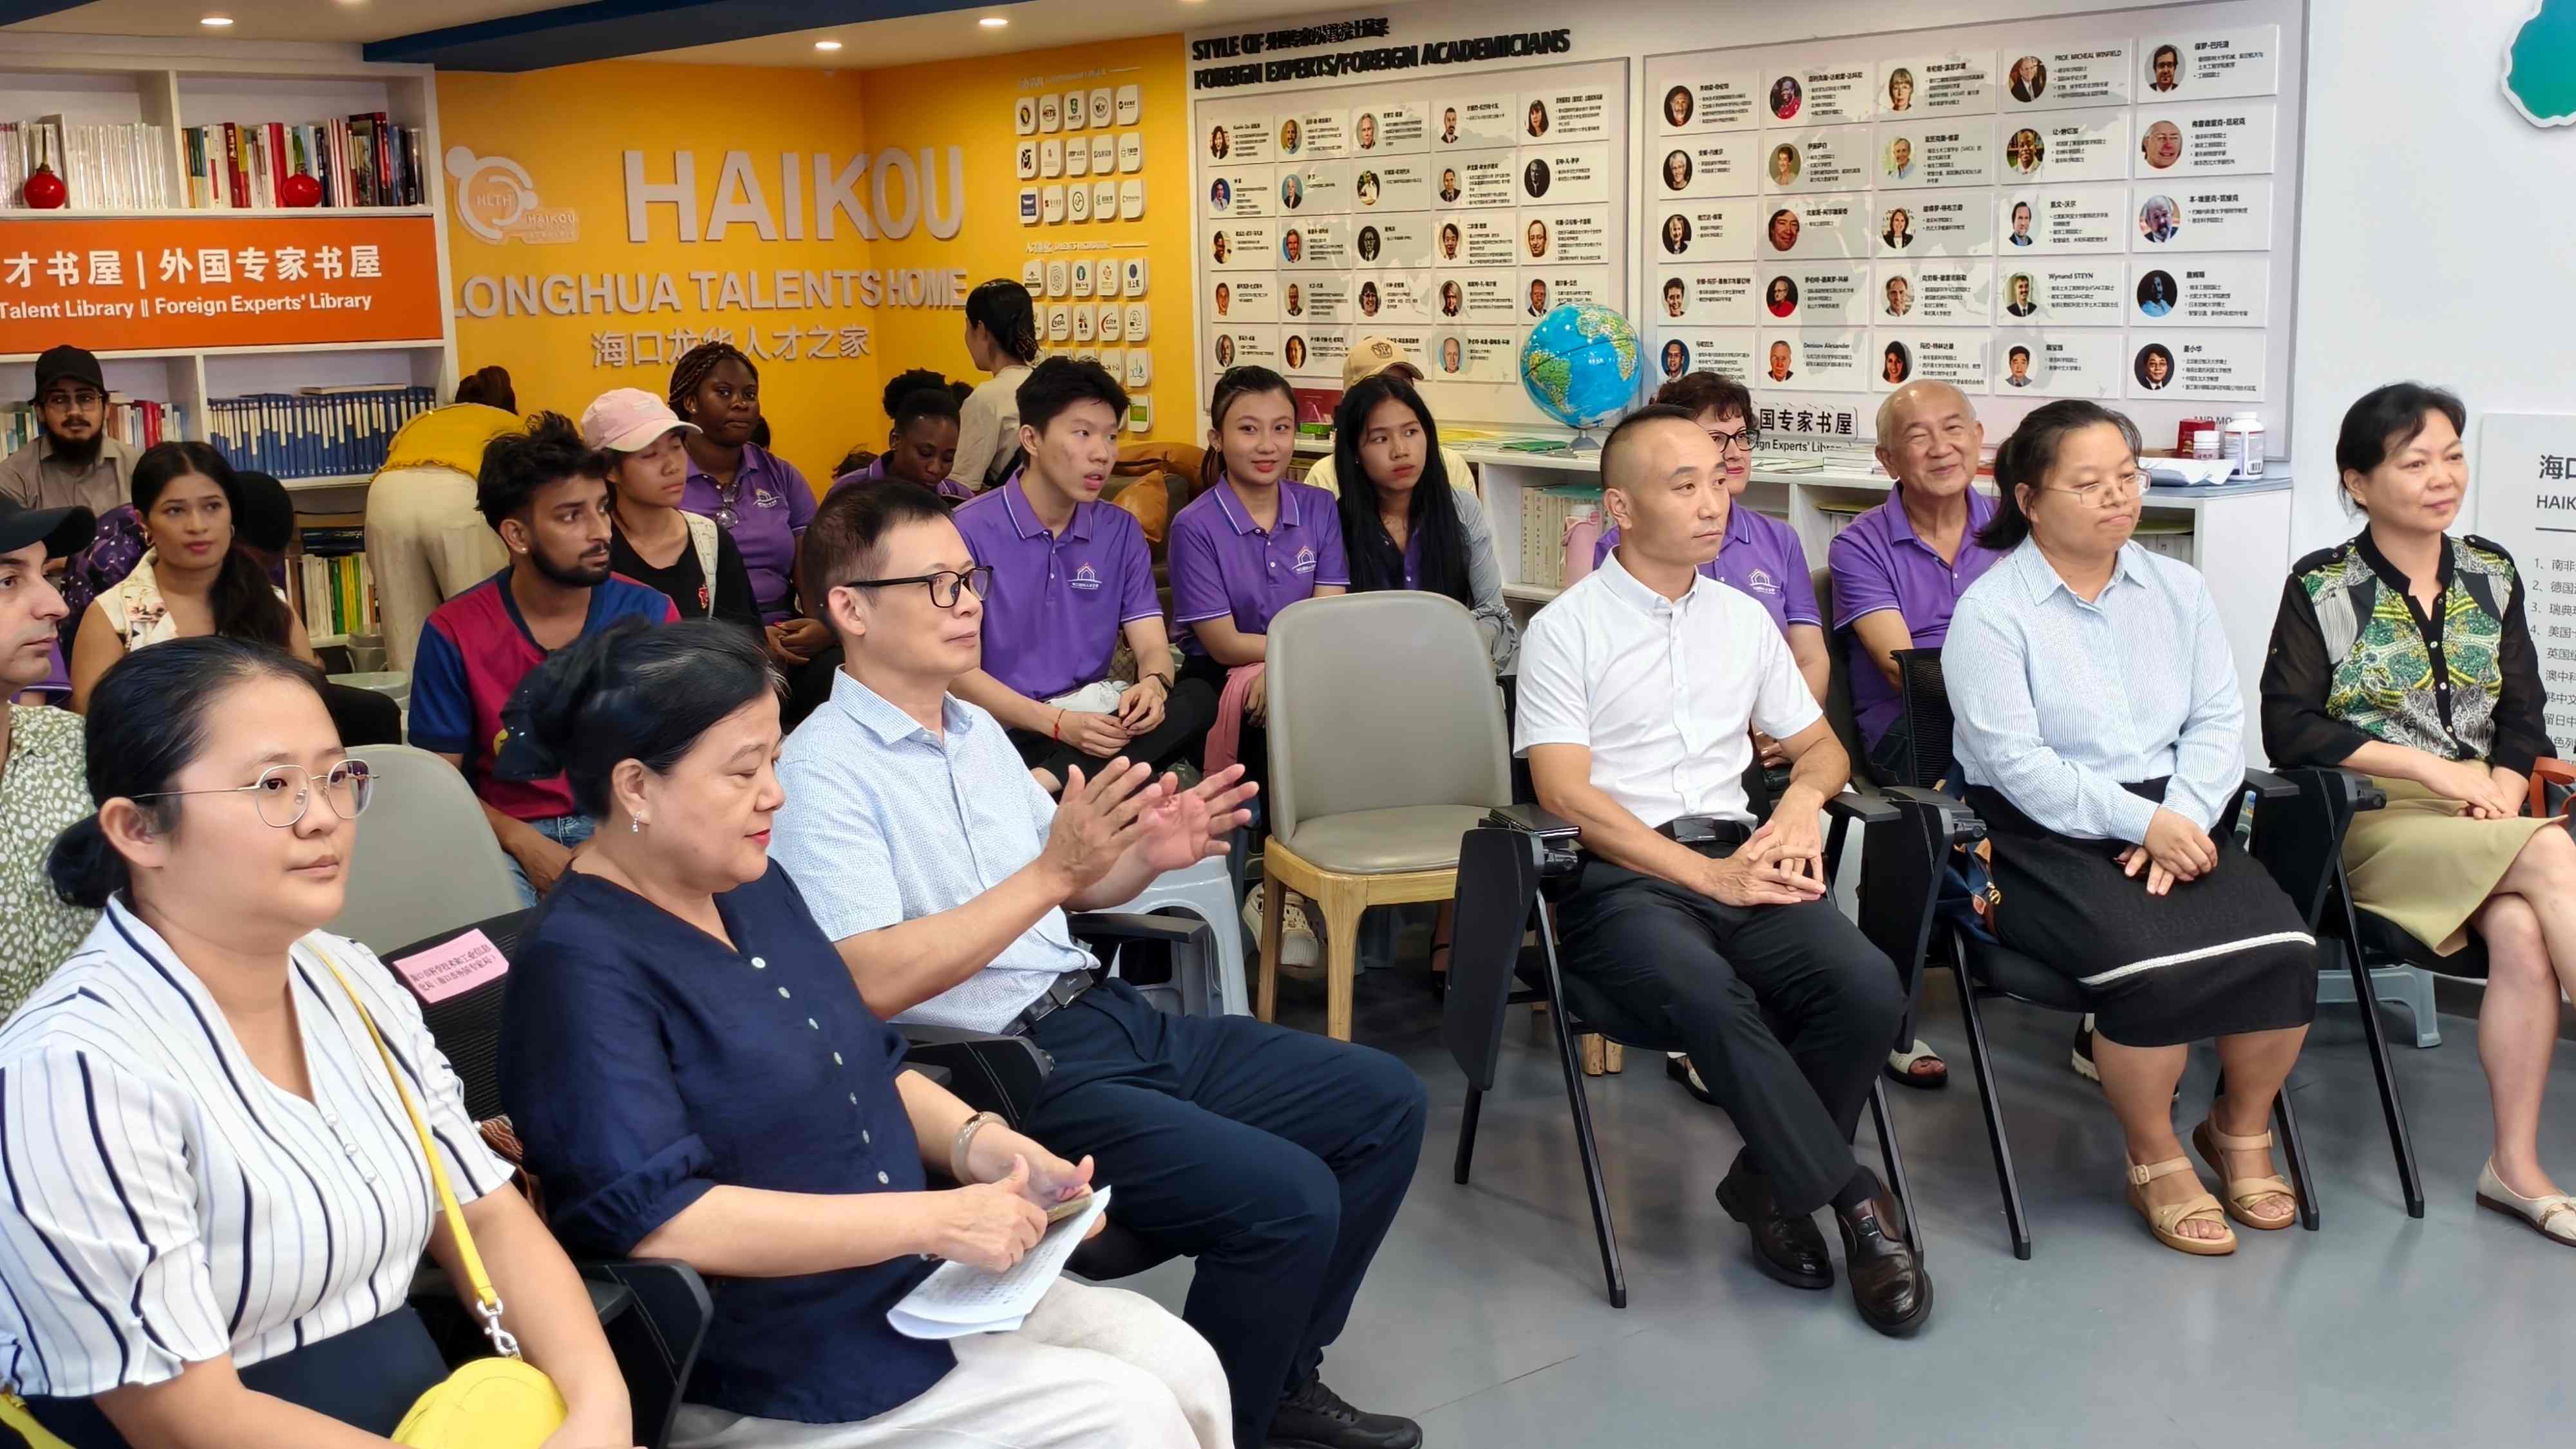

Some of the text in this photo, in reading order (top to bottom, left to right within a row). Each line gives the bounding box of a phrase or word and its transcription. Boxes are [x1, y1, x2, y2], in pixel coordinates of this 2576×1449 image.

[1192, 36, 1240, 60] STYLE
[1241, 33, 1265, 55] OF
[1194, 63, 1263, 90] FOREIGN
[1421, 29, 1571, 64] ACADEMICIANS
[622, 146, 963, 243] HAIKOU
[3, 250, 124, 288] 才书屋
[159, 245, 383, 284] 外国专家书屋
[690, 270, 883, 310] TALENTS
[887, 269, 967, 310] HOME
[0, 302, 61, 319] Talent
[66, 299, 134, 319] Library
[155, 296, 227, 316] Foreign
[231, 294, 306, 314] Experts'
[309, 293, 372, 311] Library
[1759, 408, 1853, 435] 国专家书屋
[1773, 439, 1810, 452] Experts'
[2552, 559, 2576, 572] 南非
[2550, 582, 2576, 594] 德国
